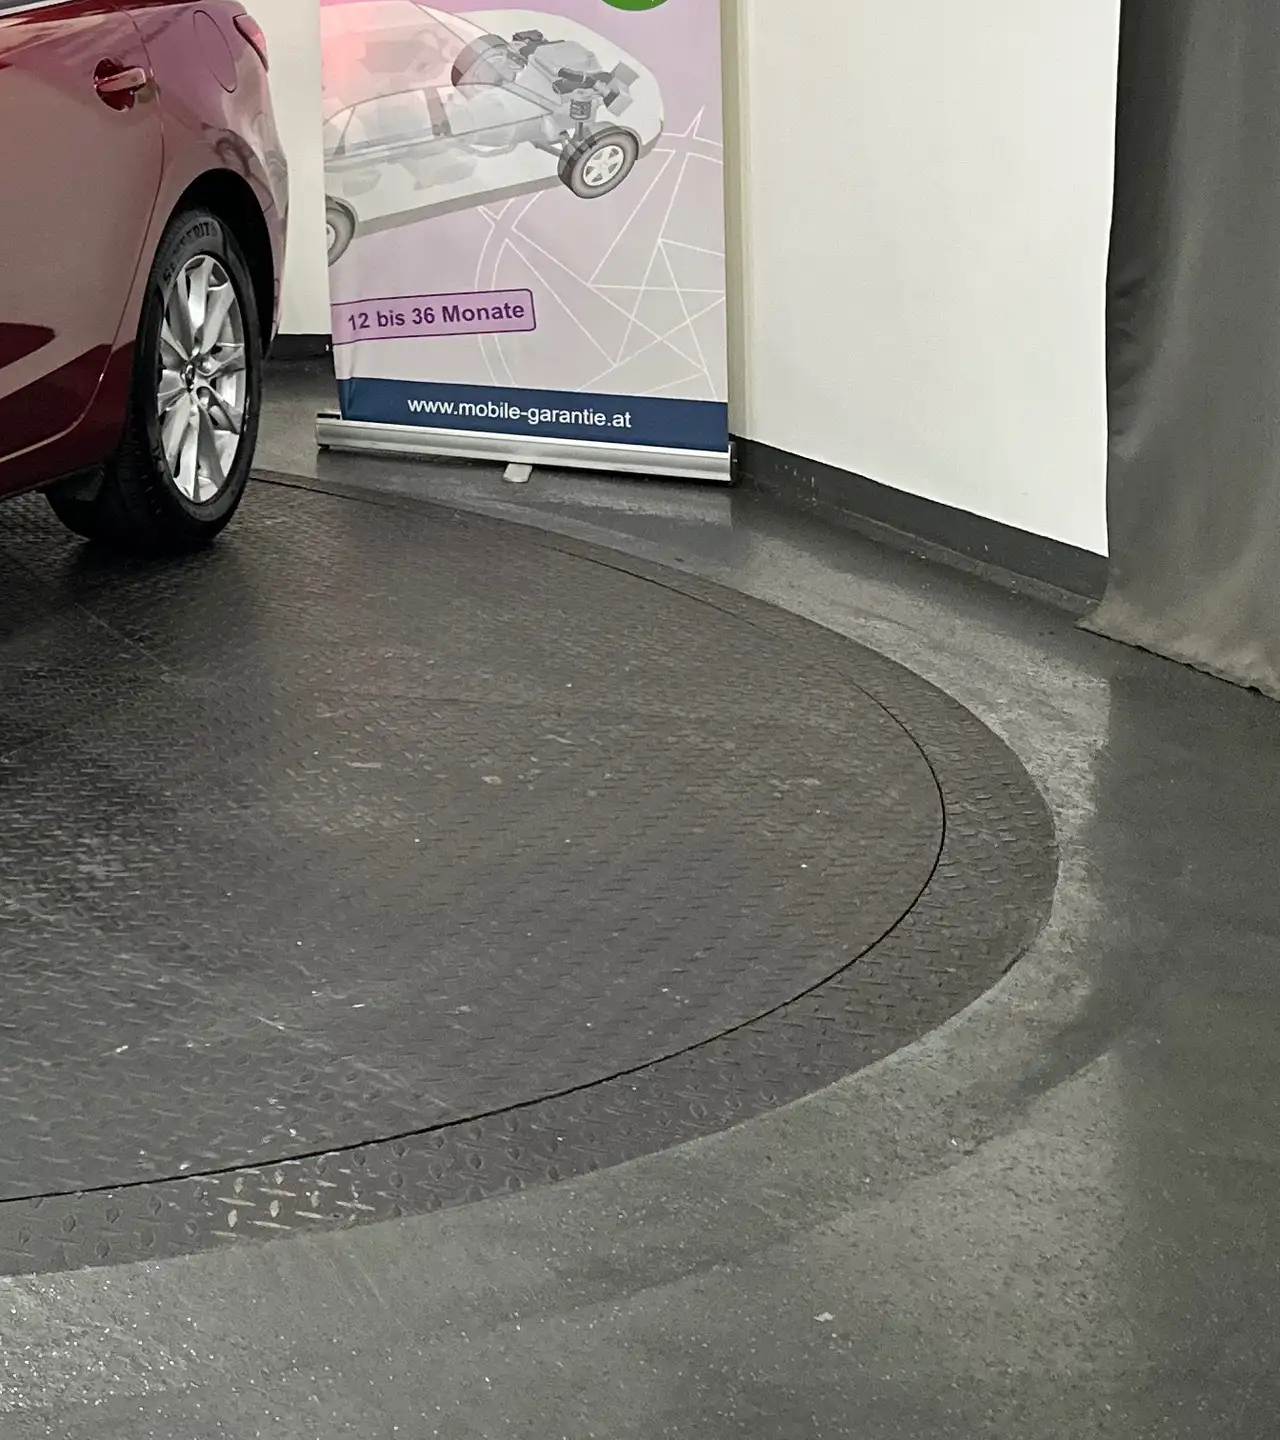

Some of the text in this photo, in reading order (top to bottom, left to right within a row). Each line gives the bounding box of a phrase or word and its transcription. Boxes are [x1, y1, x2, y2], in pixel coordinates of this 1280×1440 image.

[347, 302, 525, 332] 12 bis 36 Monate
[407, 397, 632, 428] www.mobile-garantie.at
